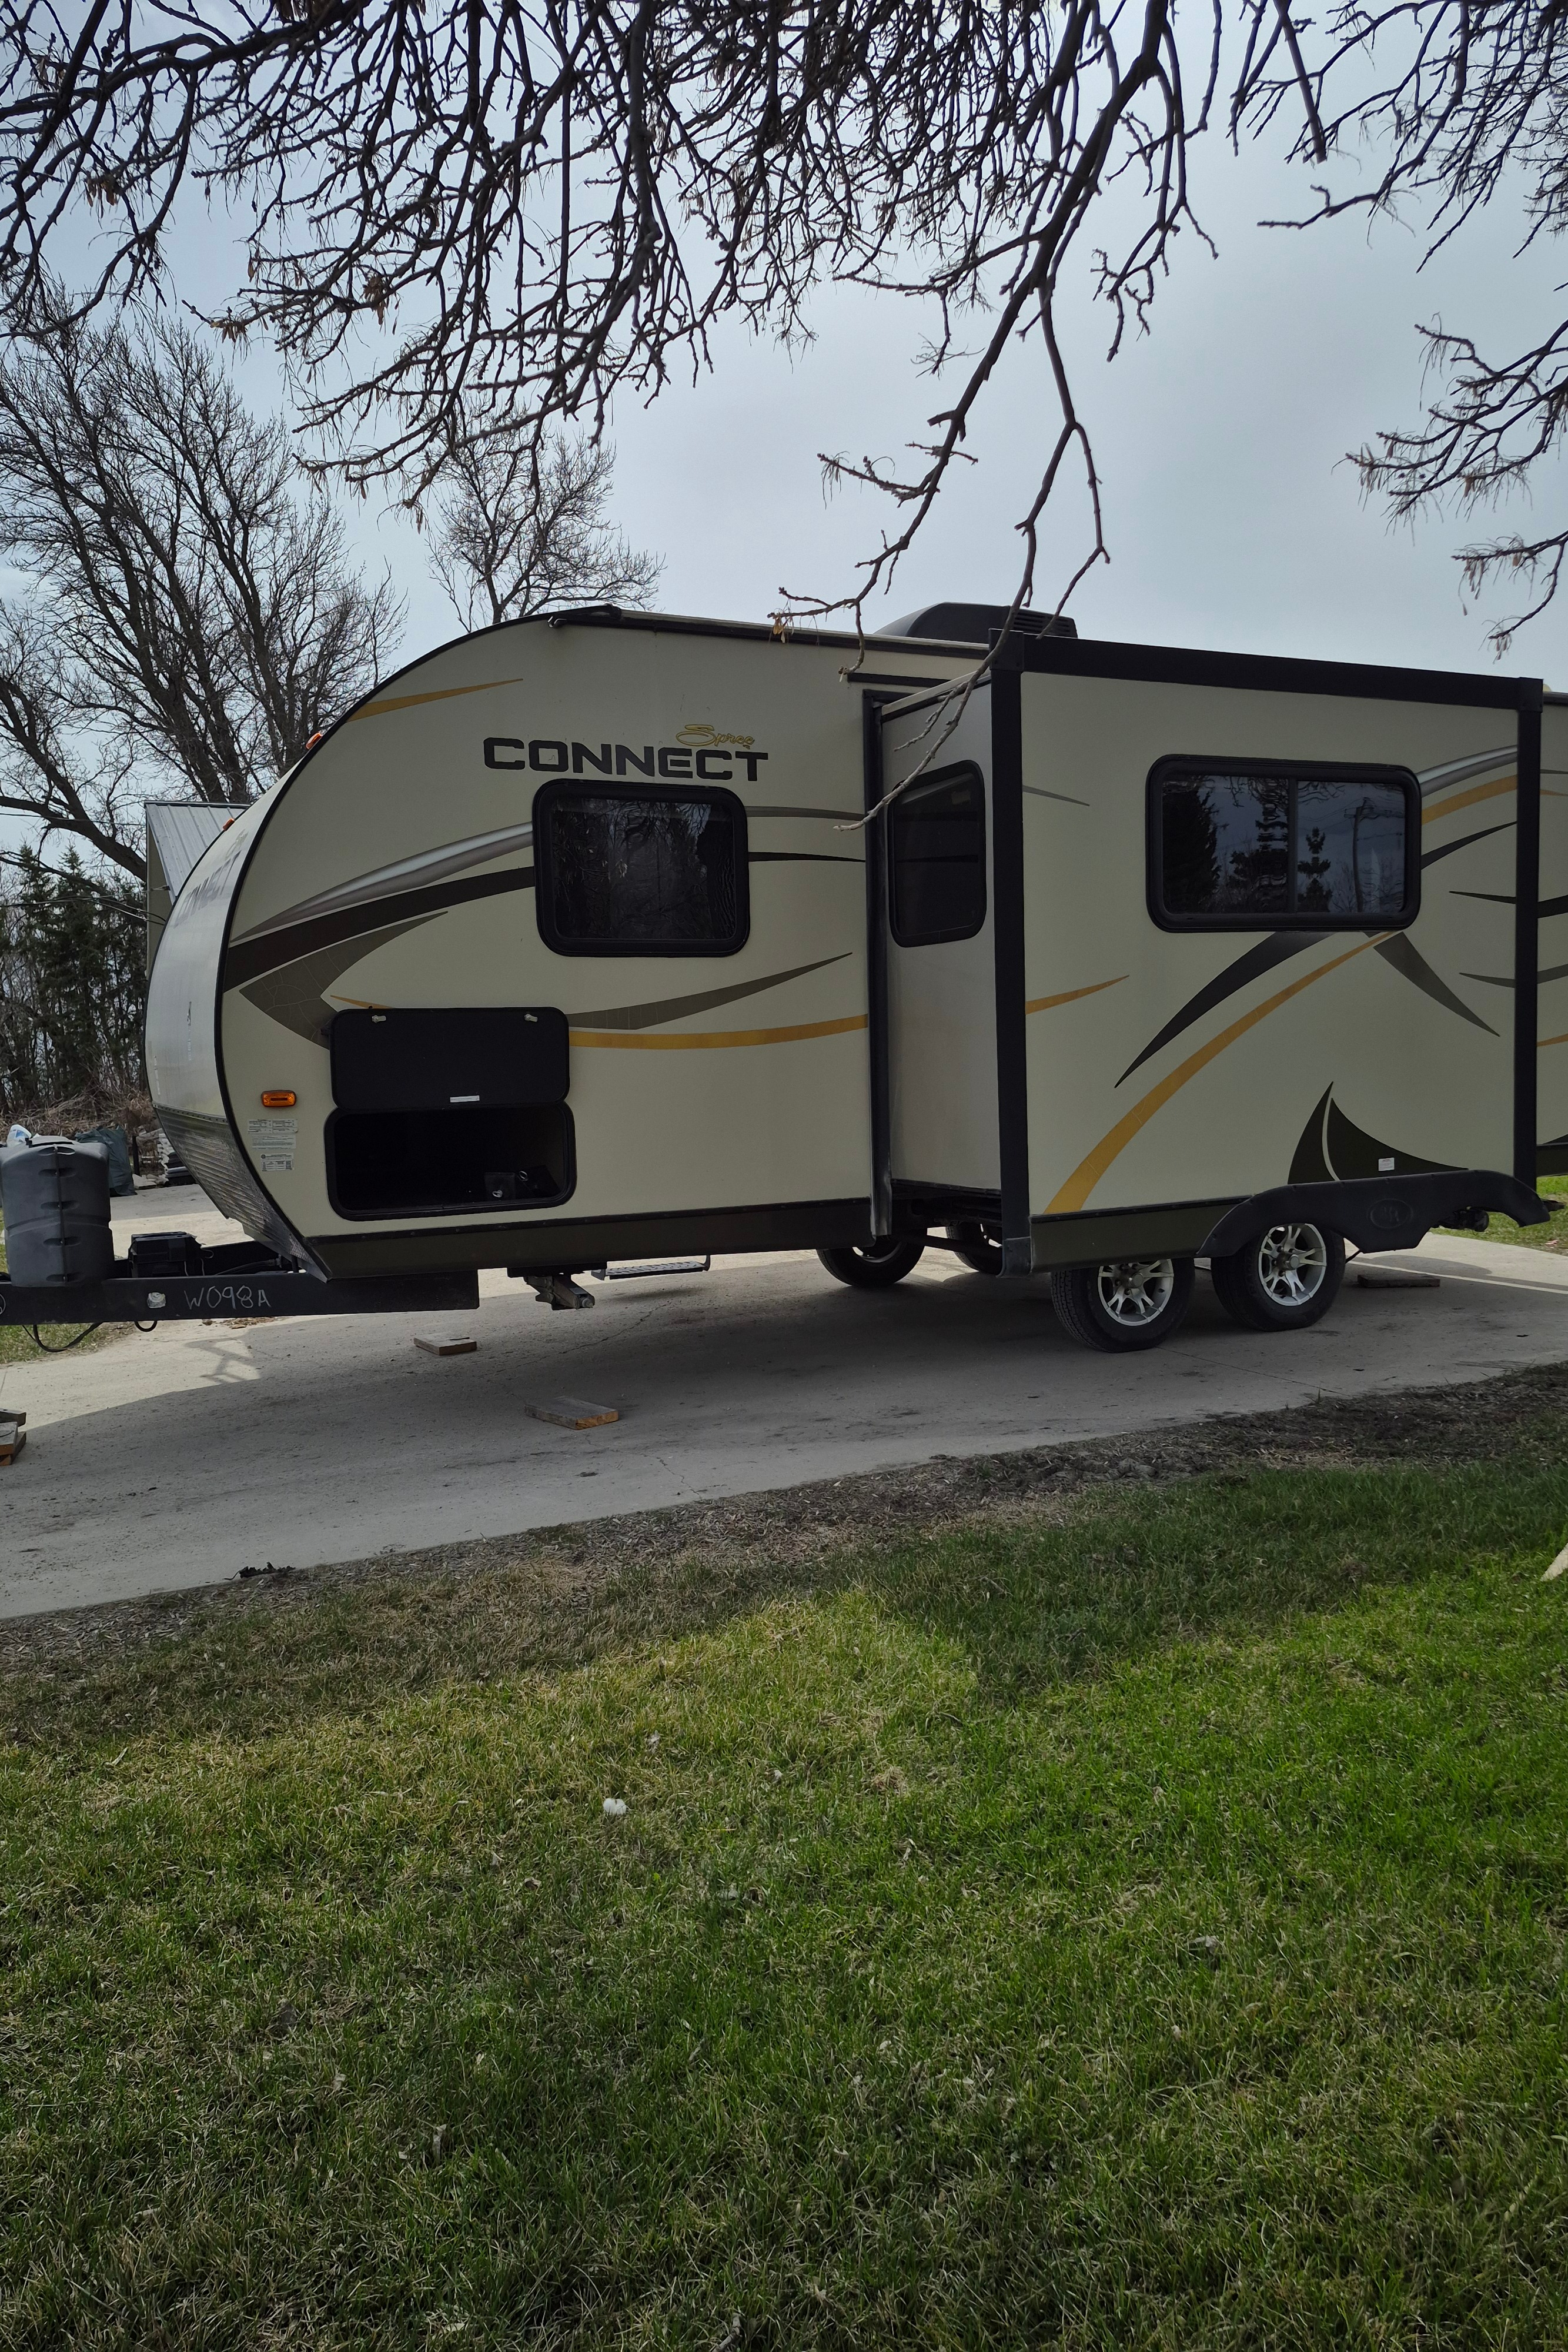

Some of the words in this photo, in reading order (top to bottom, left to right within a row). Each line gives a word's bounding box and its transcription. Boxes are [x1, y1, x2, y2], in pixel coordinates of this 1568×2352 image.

[676, 724, 755, 747] Spree
[483, 737, 769, 781] CONNECT
[184, 1285, 272, 1310] W098A
